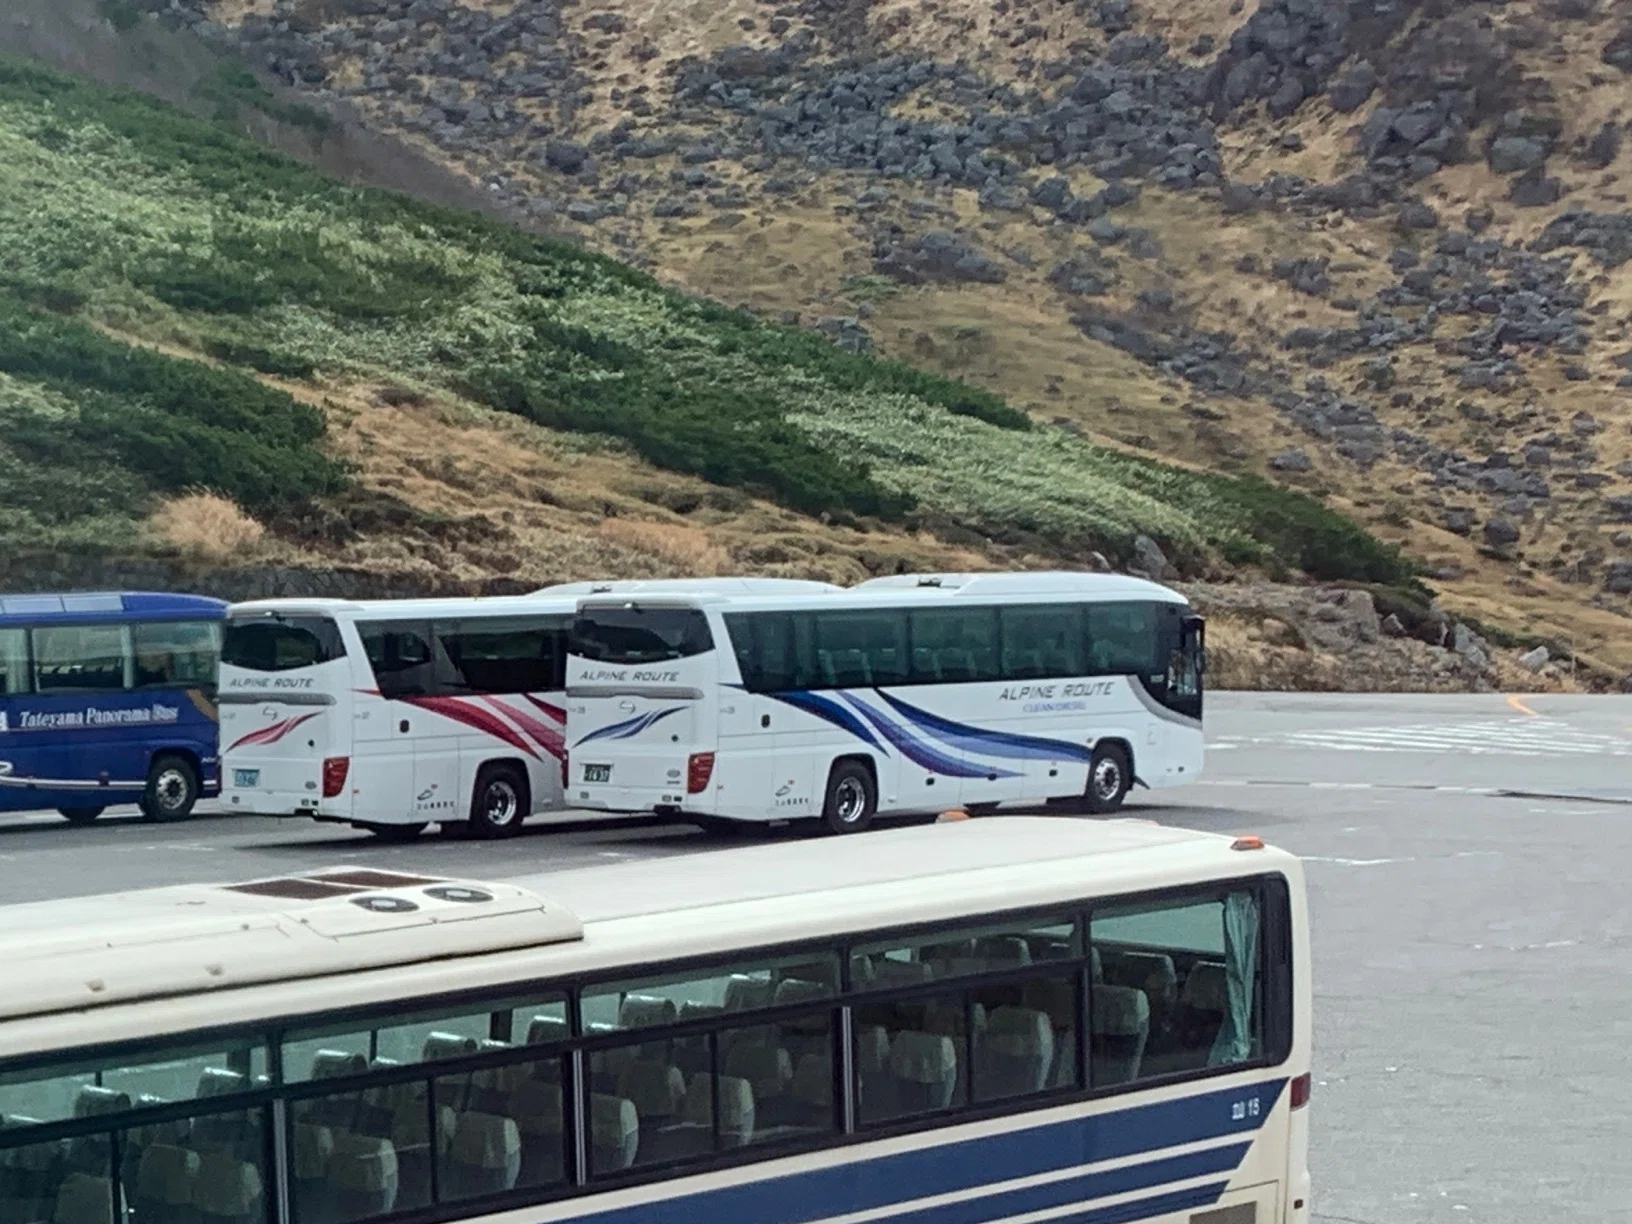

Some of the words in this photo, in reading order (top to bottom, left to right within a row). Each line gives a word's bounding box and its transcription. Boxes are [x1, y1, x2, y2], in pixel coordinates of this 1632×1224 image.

[230, 678, 270, 688] ALPINE
[274, 678, 313, 688] ROUTE
[580, 671, 627, 681] ALPINE
[632, 671, 680, 682] ROUTE
[999, 685, 1056, 700] ALPINE
[1062, 681, 1115, 697] ROUTE
[20, 710, 83, 728] Tateyama
[86, 707, 150, 725] Panorama
